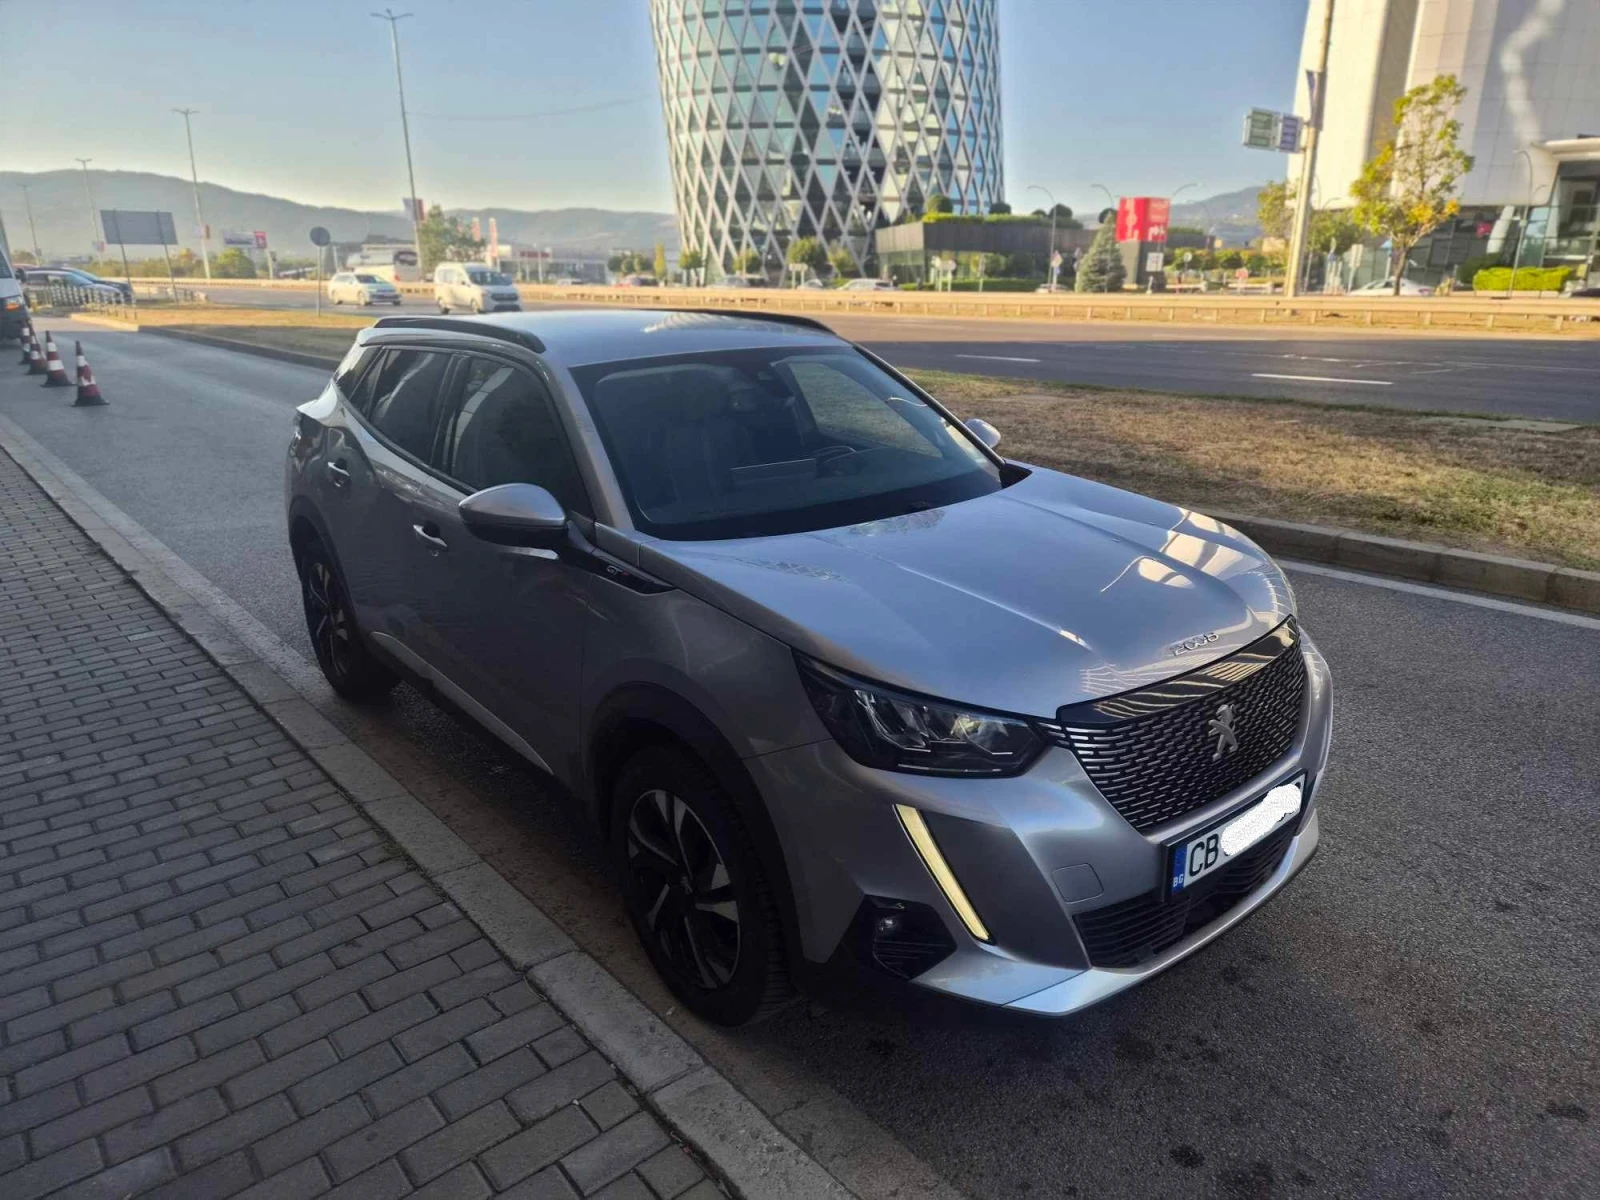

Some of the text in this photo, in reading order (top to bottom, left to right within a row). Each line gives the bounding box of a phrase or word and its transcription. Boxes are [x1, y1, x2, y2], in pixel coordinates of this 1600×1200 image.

[1170, 632, 1219, 656] 2008
[1189, 834, 1219, 877] CB
[1173, 874, 1184, 888] BG
